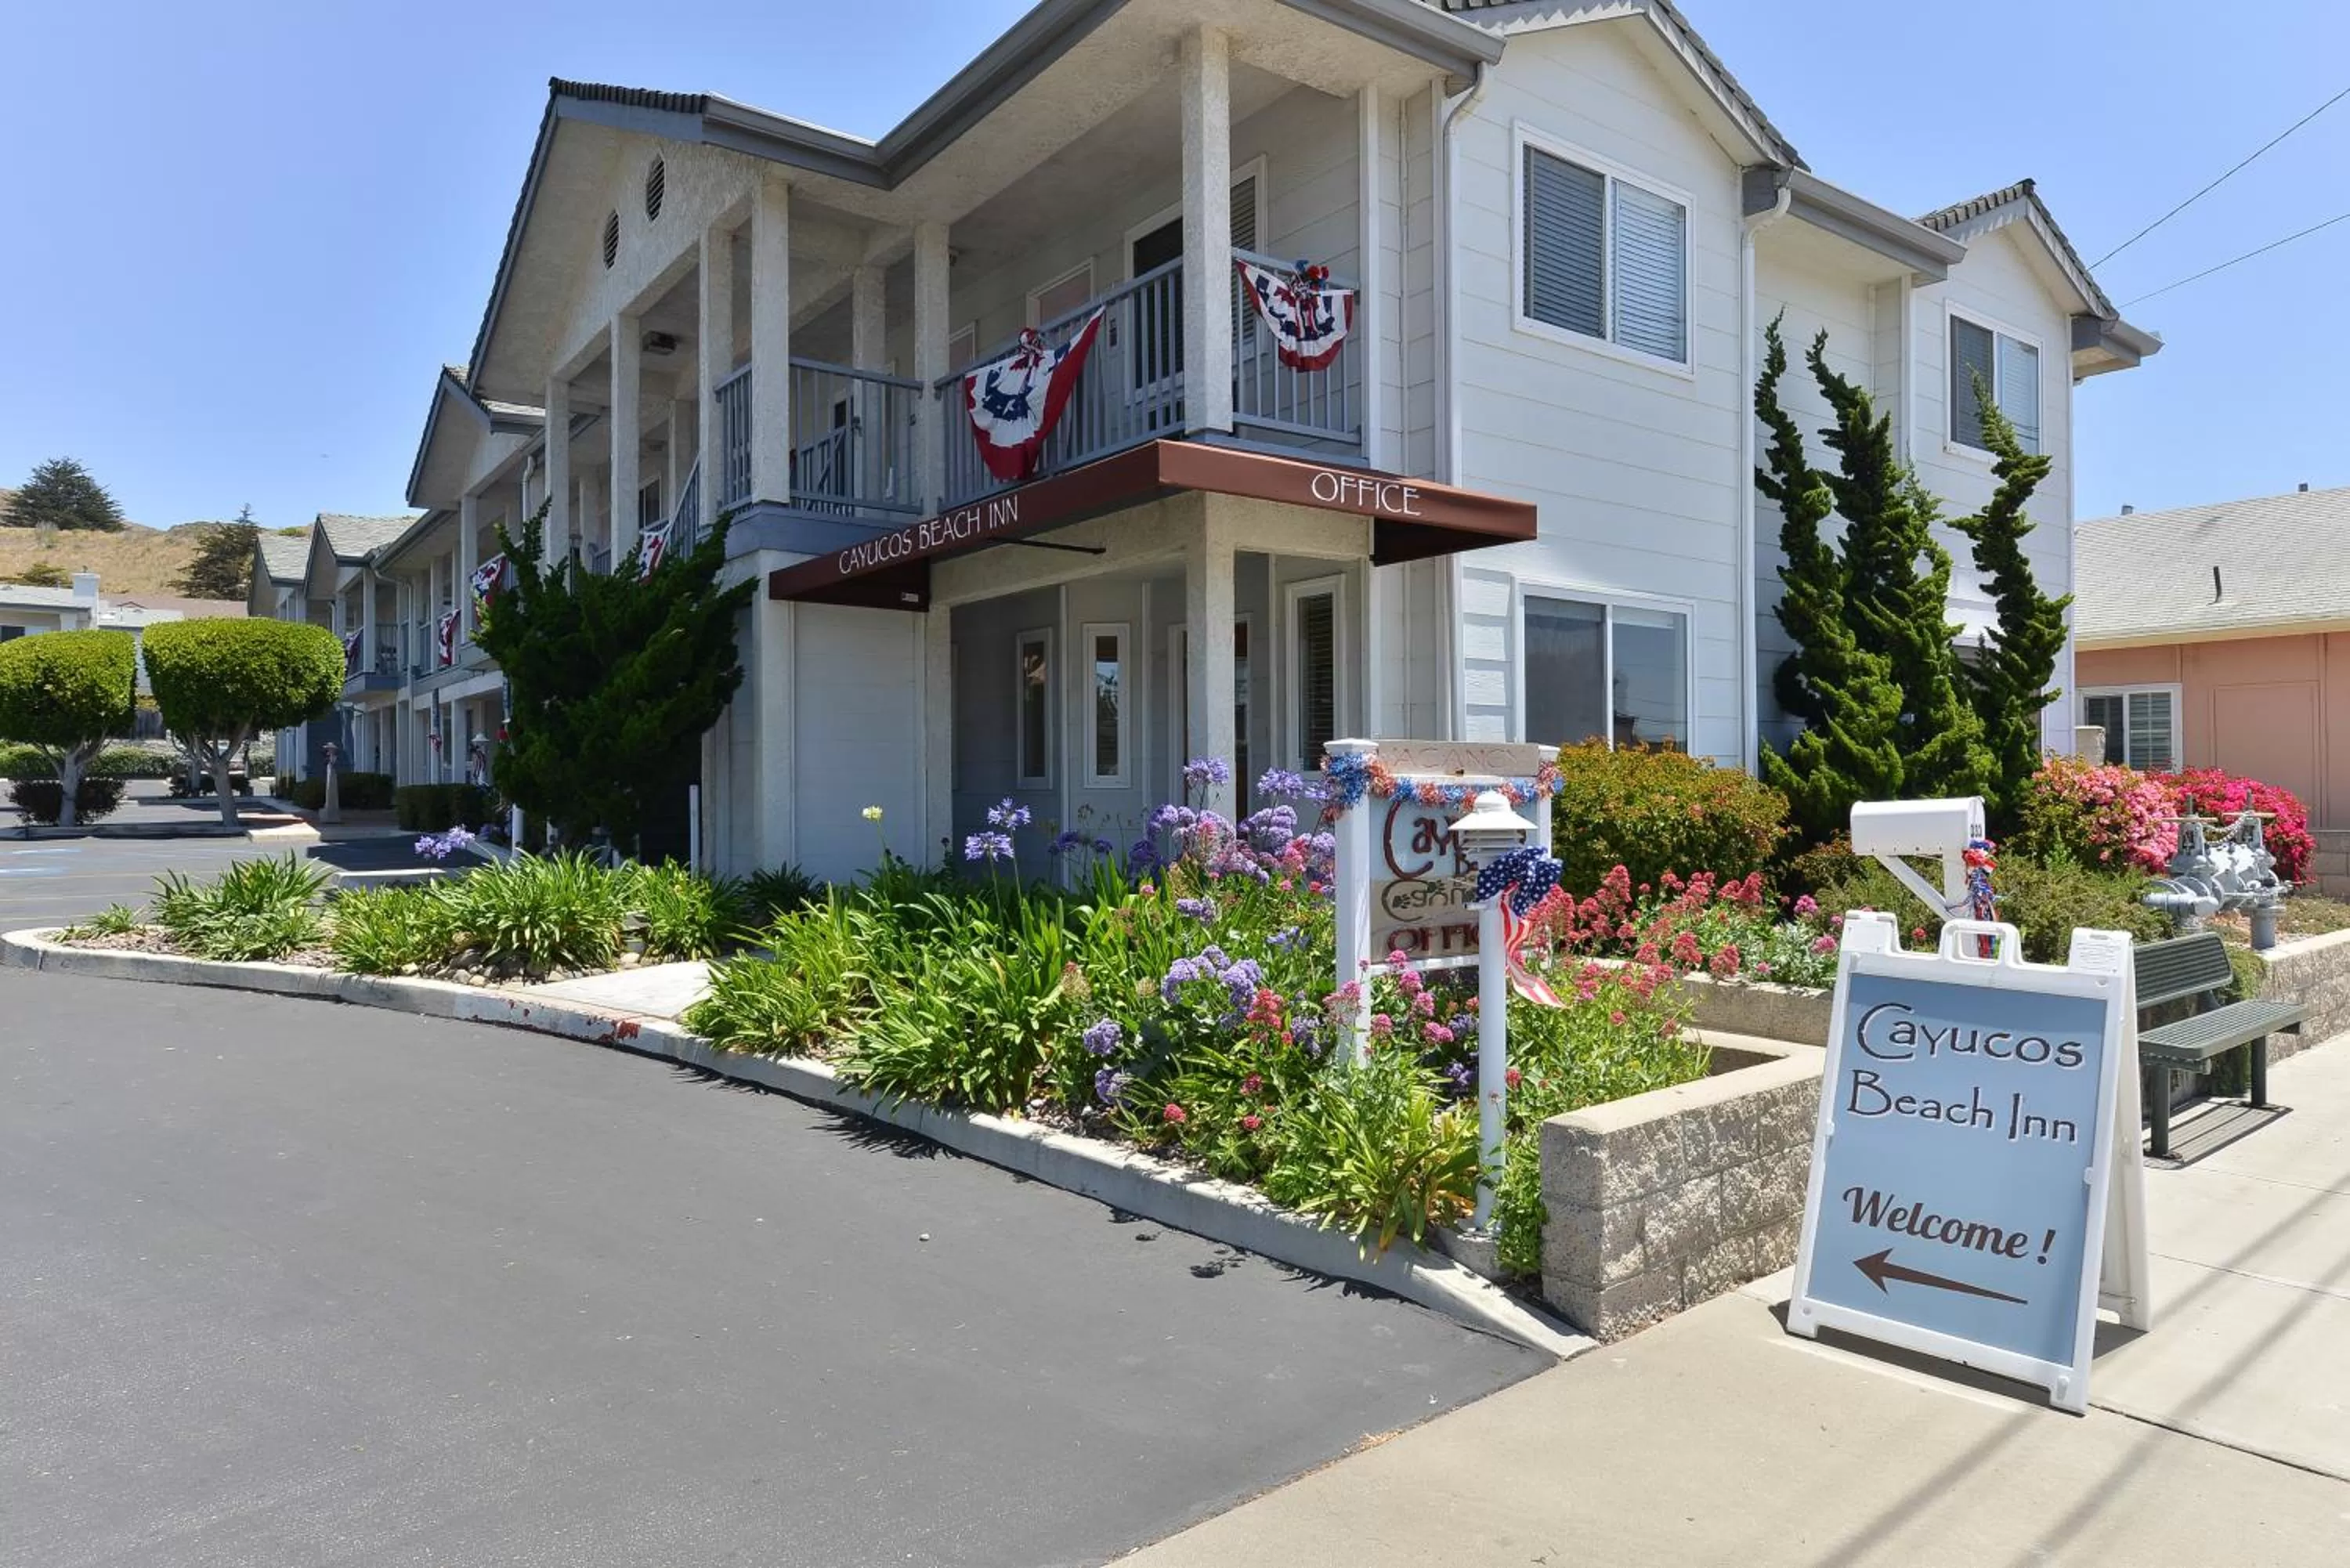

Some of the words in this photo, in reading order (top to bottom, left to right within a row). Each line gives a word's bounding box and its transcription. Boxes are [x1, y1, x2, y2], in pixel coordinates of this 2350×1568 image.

[1311, 472, 1422, 516] OFFICE
[838, 528, 913, 575] CAYUCOS
[918, 506, 982, 550] BEACH
[989, 494, 1018, 529] INN
[1856, 1003, 2084, 1068] Cayucos
[1846, 1069, 1994, 1129] Beach
[2008, 1093, 2076, 1143] Inn
